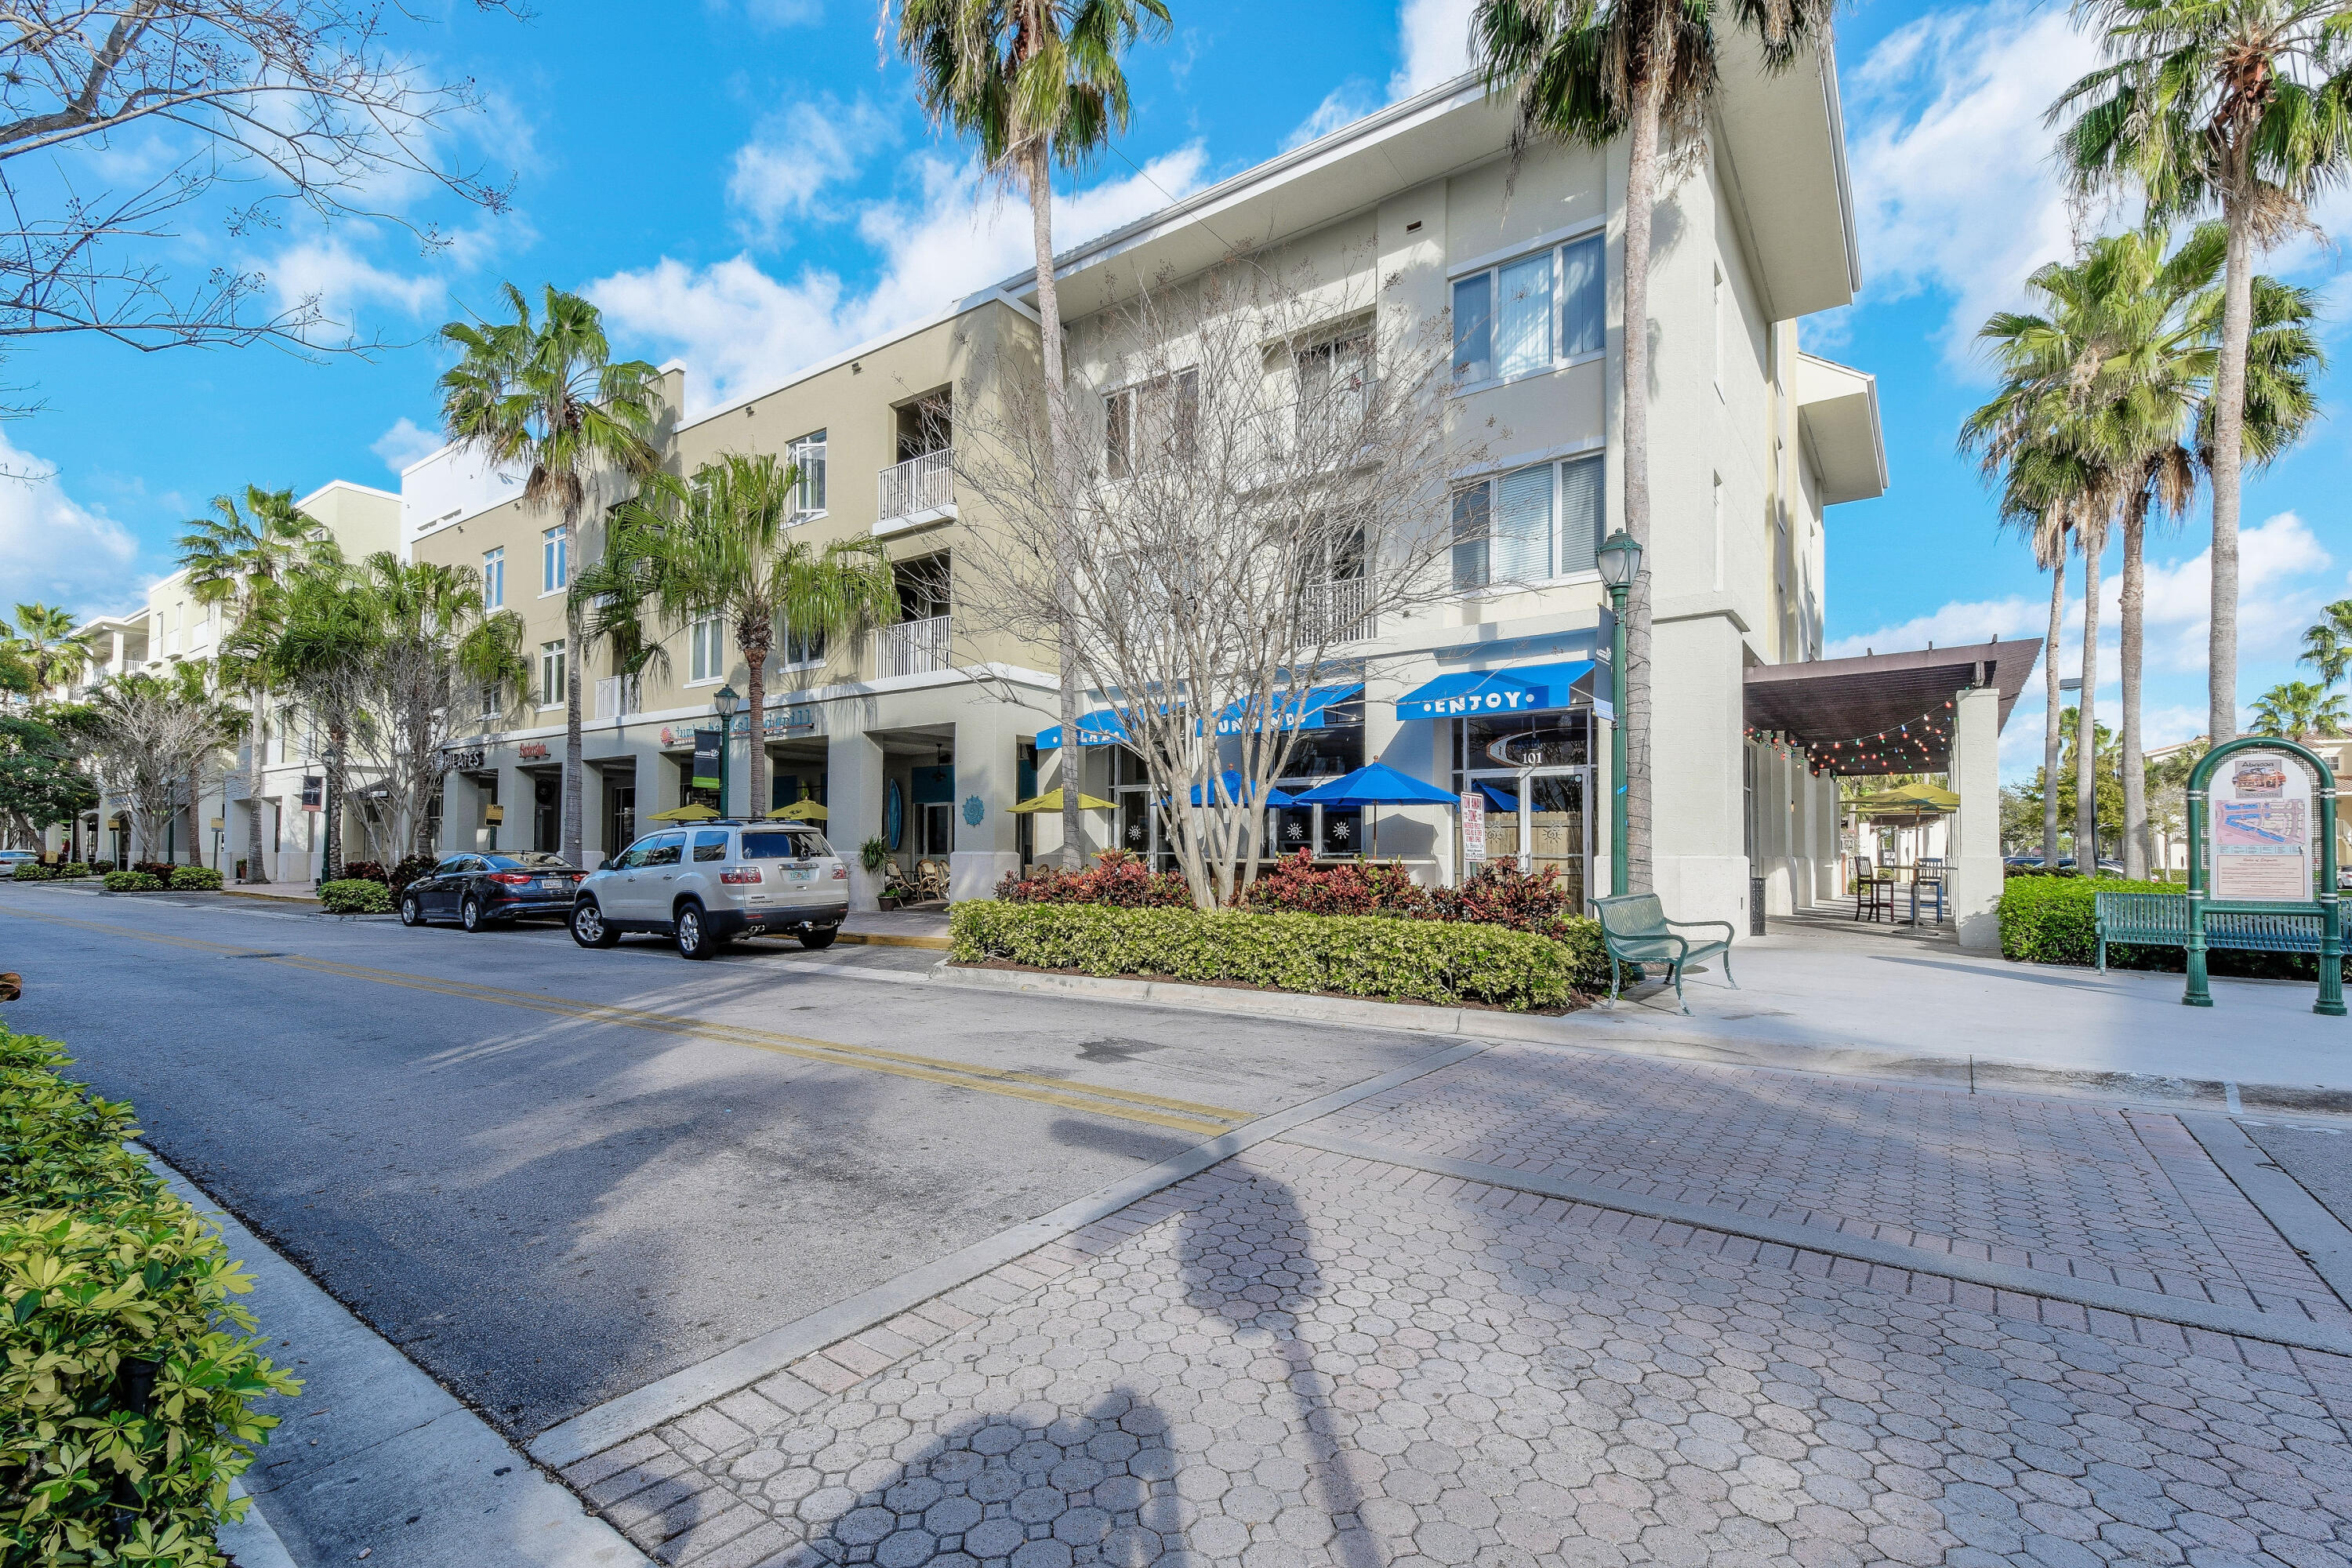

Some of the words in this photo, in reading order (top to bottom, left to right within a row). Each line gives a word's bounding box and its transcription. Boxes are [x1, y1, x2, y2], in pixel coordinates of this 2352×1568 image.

[1436, 691, 1521, 713] ENJOY
[444, 751, 479, 769] PILATES
[1523, 752, 1542, 764] 101
